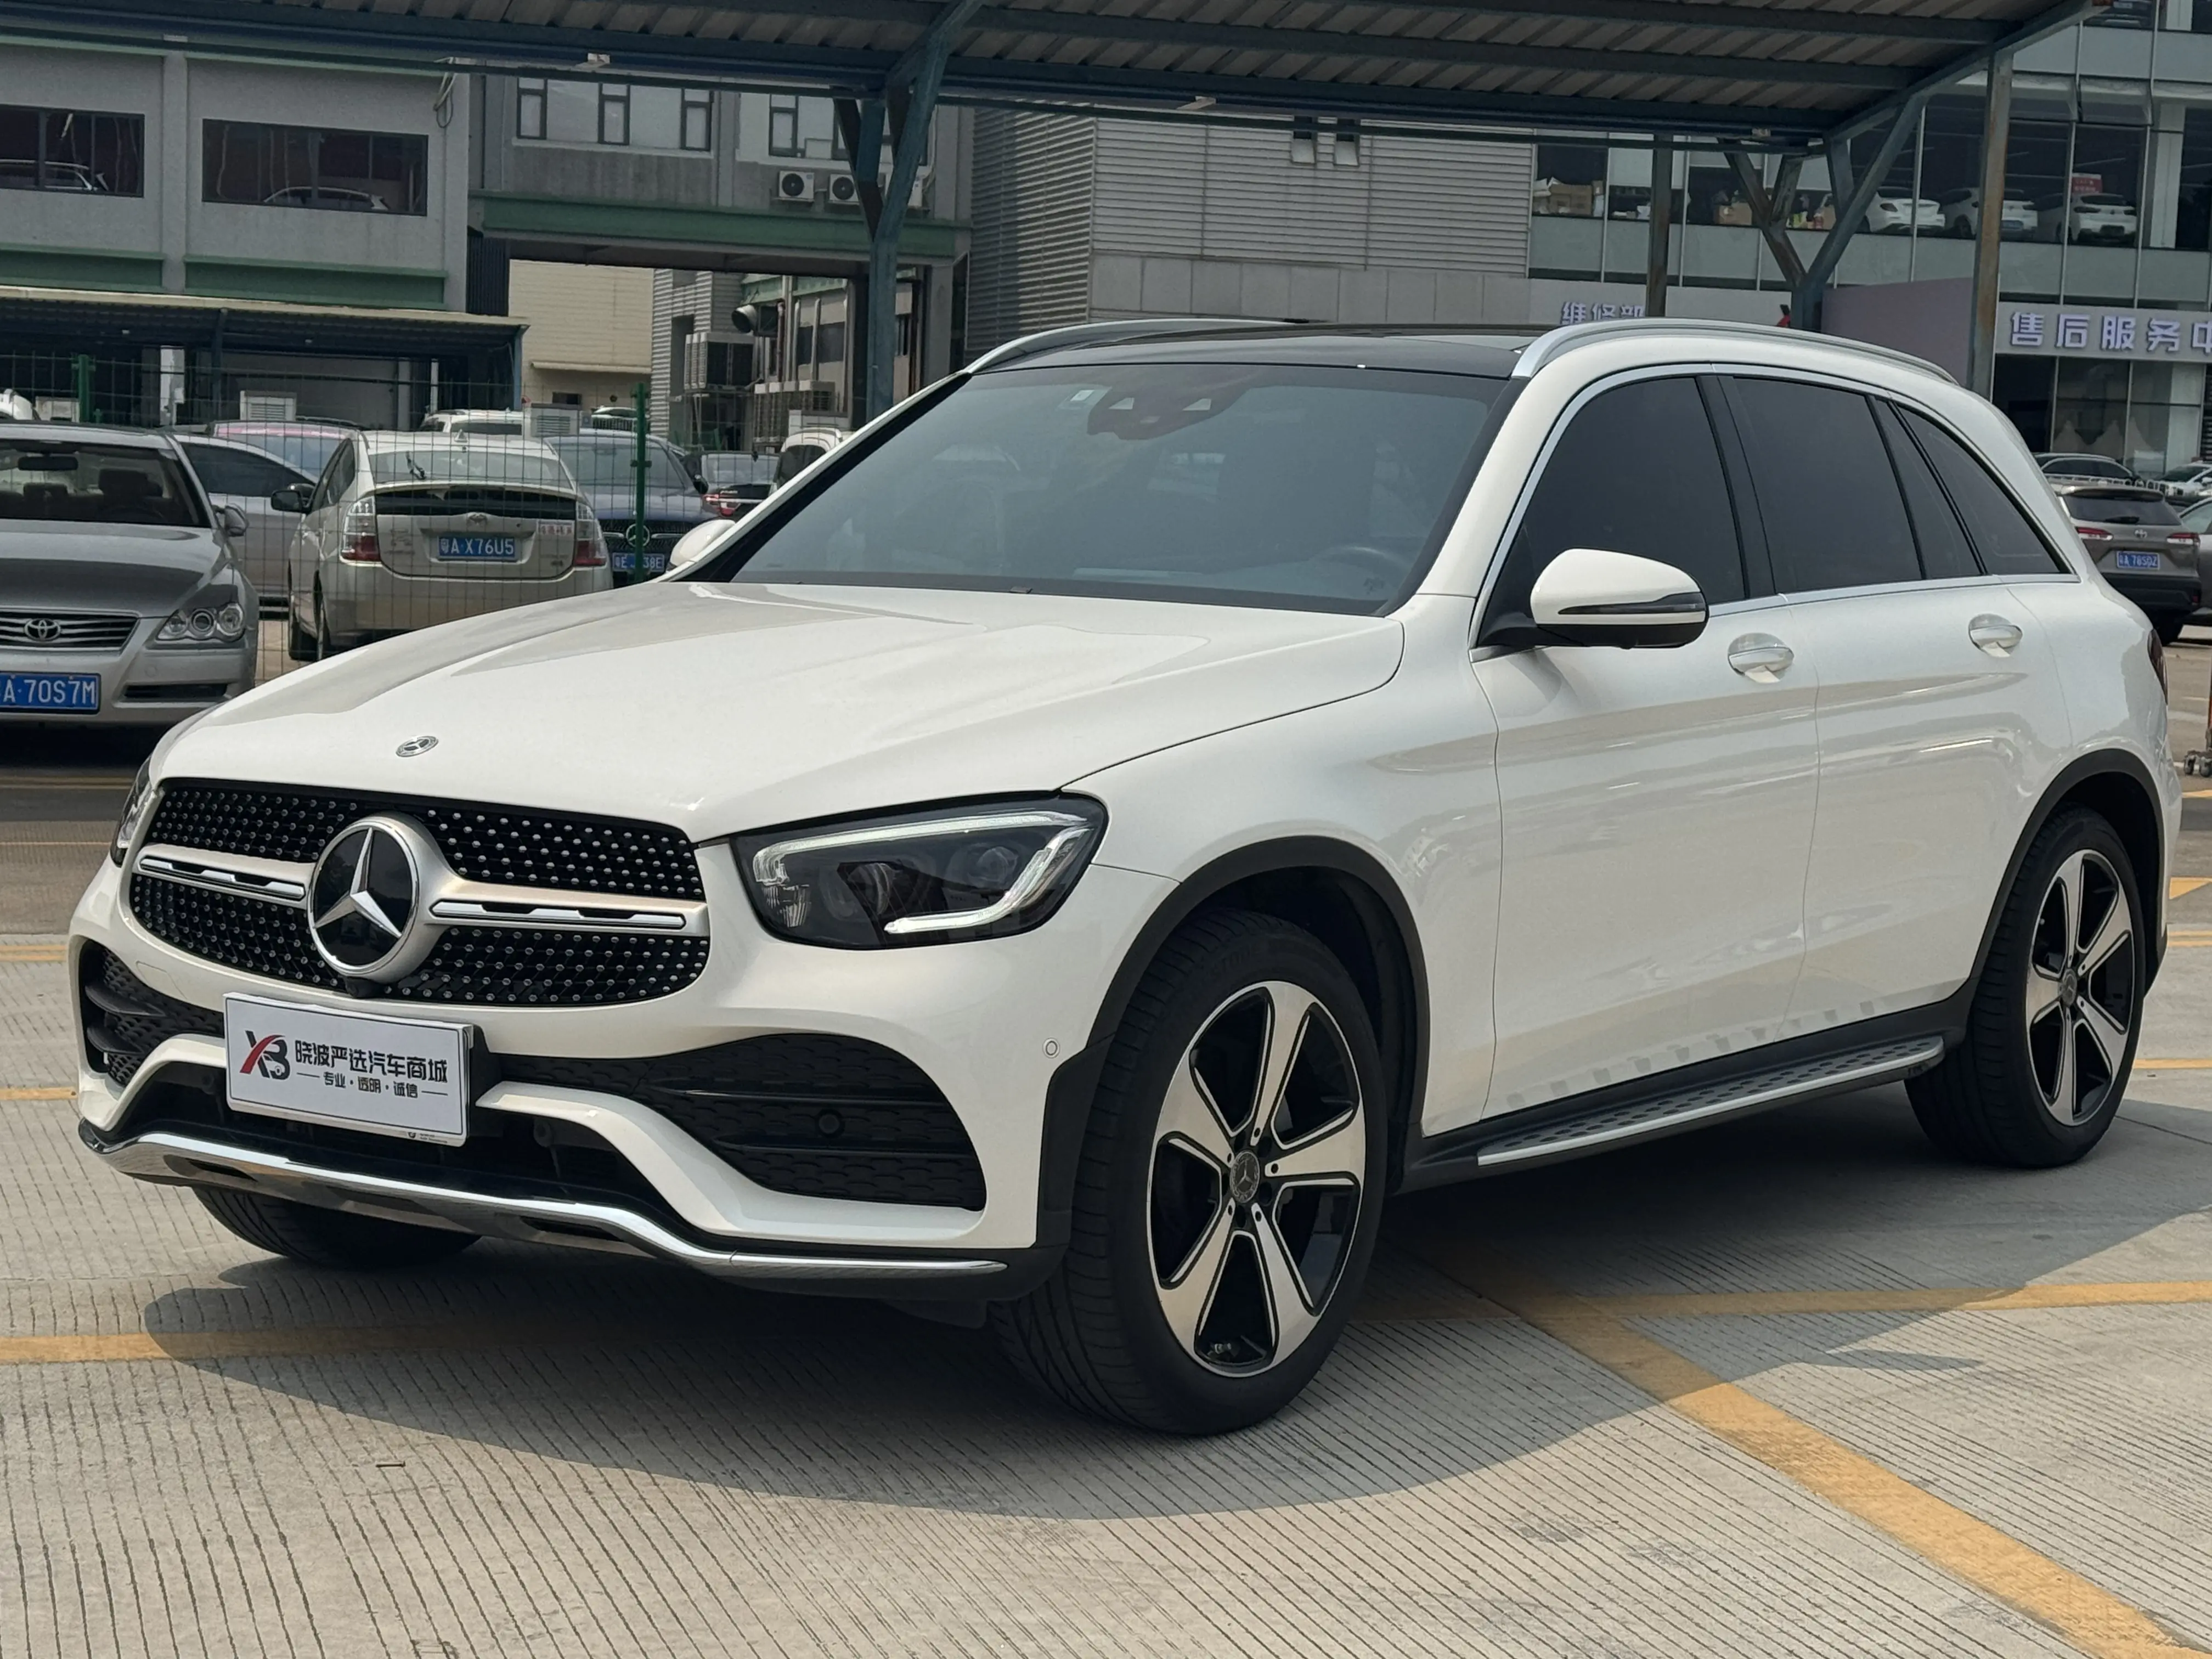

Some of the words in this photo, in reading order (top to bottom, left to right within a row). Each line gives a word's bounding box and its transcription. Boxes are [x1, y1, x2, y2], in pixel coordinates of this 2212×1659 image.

[295, 1040, 448, 1084] 晓波严选汽车商城
